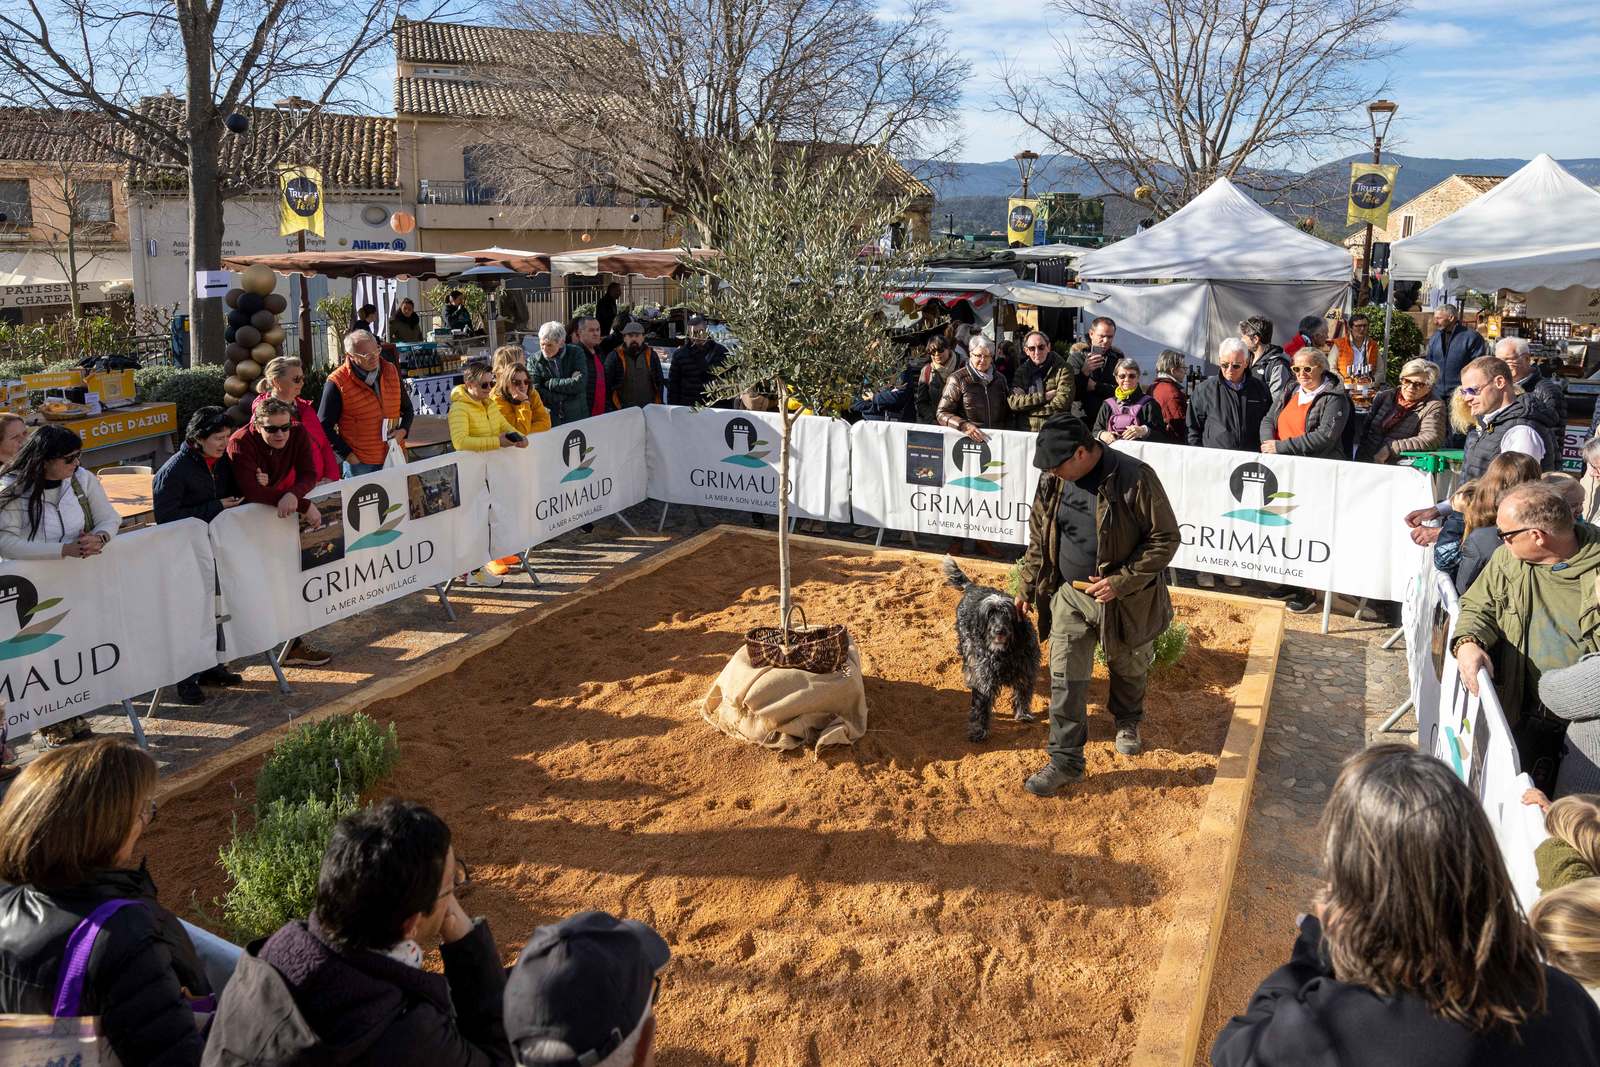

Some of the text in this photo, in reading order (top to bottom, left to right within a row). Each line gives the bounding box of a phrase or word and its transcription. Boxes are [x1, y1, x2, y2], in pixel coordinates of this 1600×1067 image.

[1355, 182, 1384, 193] TRUFF
[352, 239, 390, 250] Allianz
[15, 293, 81, 306] CHATEA
[91, 420, 124, 437] CÔTE
[127, 413, 169, 430] D'AZUR
[535, 477, 612, 520] GRIMAUD
[910, 491, 1032, 522] GRIMAUD
[939, 520, 955, 529] MER
[963, 523, 982, 532] SON
[982, 526, 1014, 535] VILLAGE
[1178, 523, 1331, 563] GRIMAUD
[302, 540, 434, 603] GRIMAUD
[1195, 555, 1304, 578] LA MER A SON VILLAGE
[325, 574, 417, 615] LA MER A SON VILLAGE
[8, 690, 91, 726] ON VILLAGE
